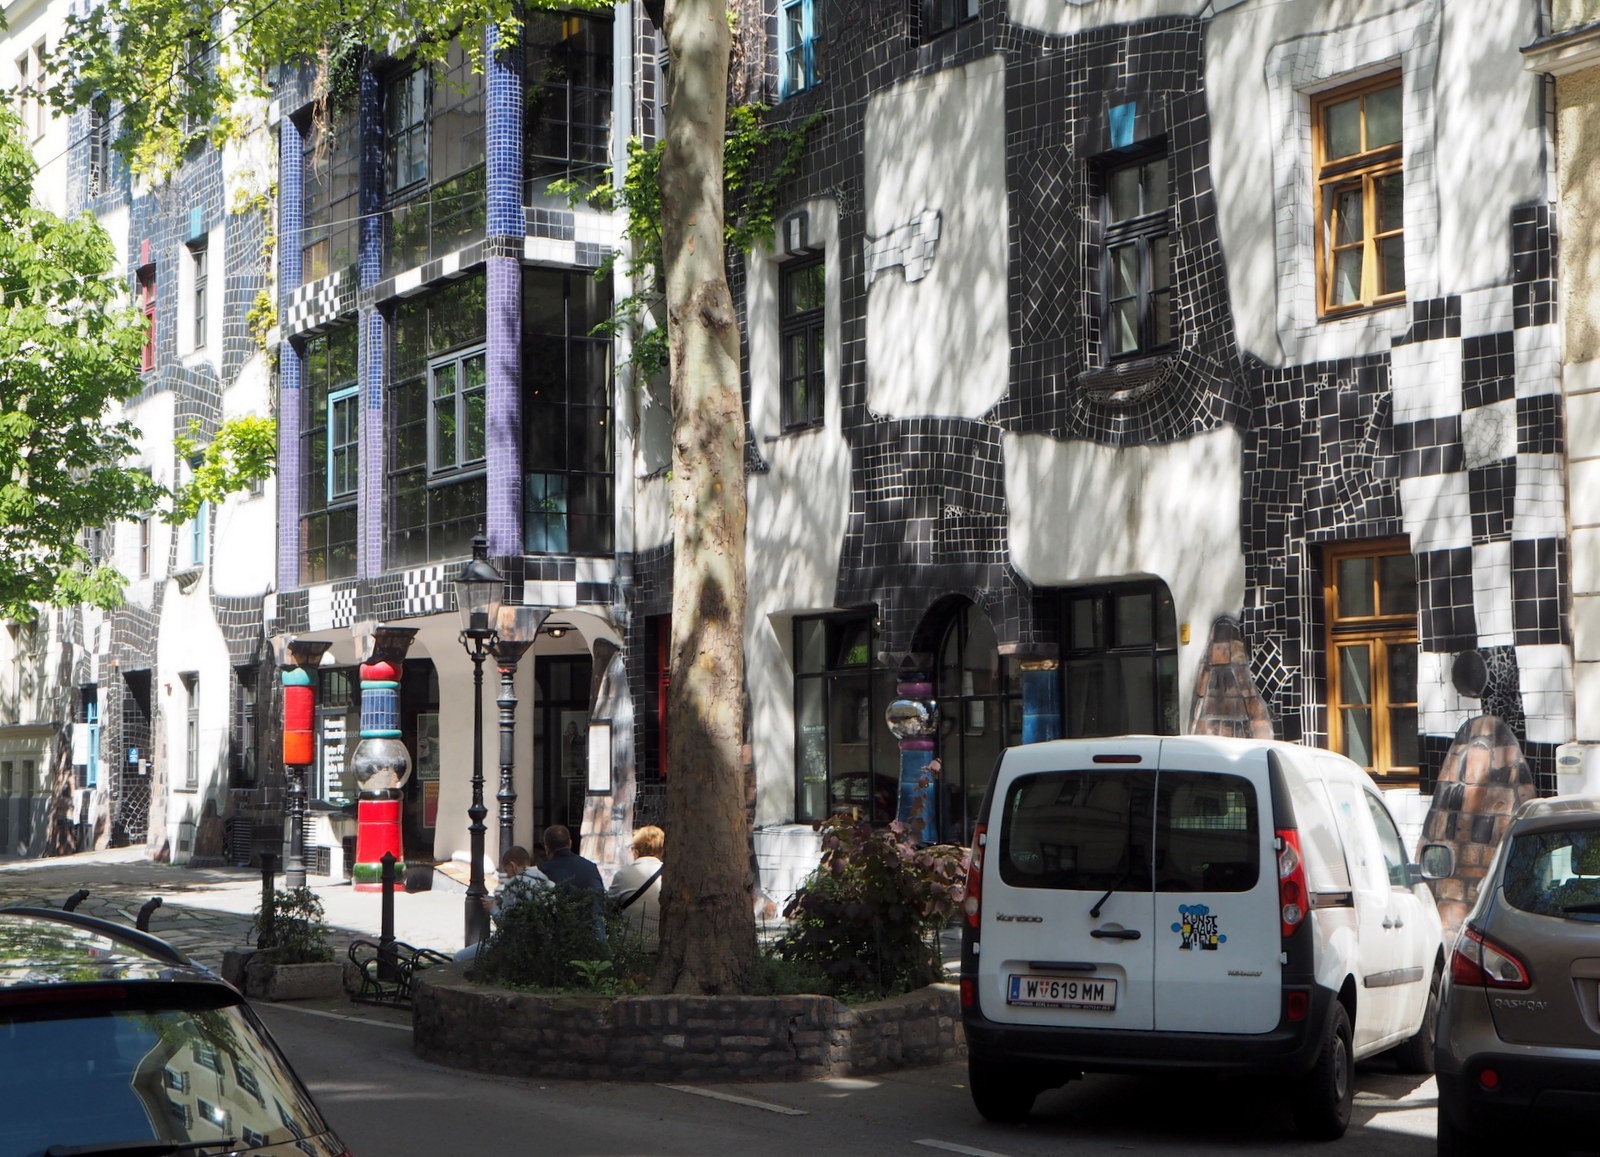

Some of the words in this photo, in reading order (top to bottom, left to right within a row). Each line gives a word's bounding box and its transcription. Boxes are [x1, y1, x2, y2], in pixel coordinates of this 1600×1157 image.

[1182, 912, 1218, 925] KUNST
[1190, 922, 1218, 936] HAUS
[1027, 980, 1039, 998] W
[1050, 982, 1078, 1000] 619
[1081, 983, 1104, 1001] MM
